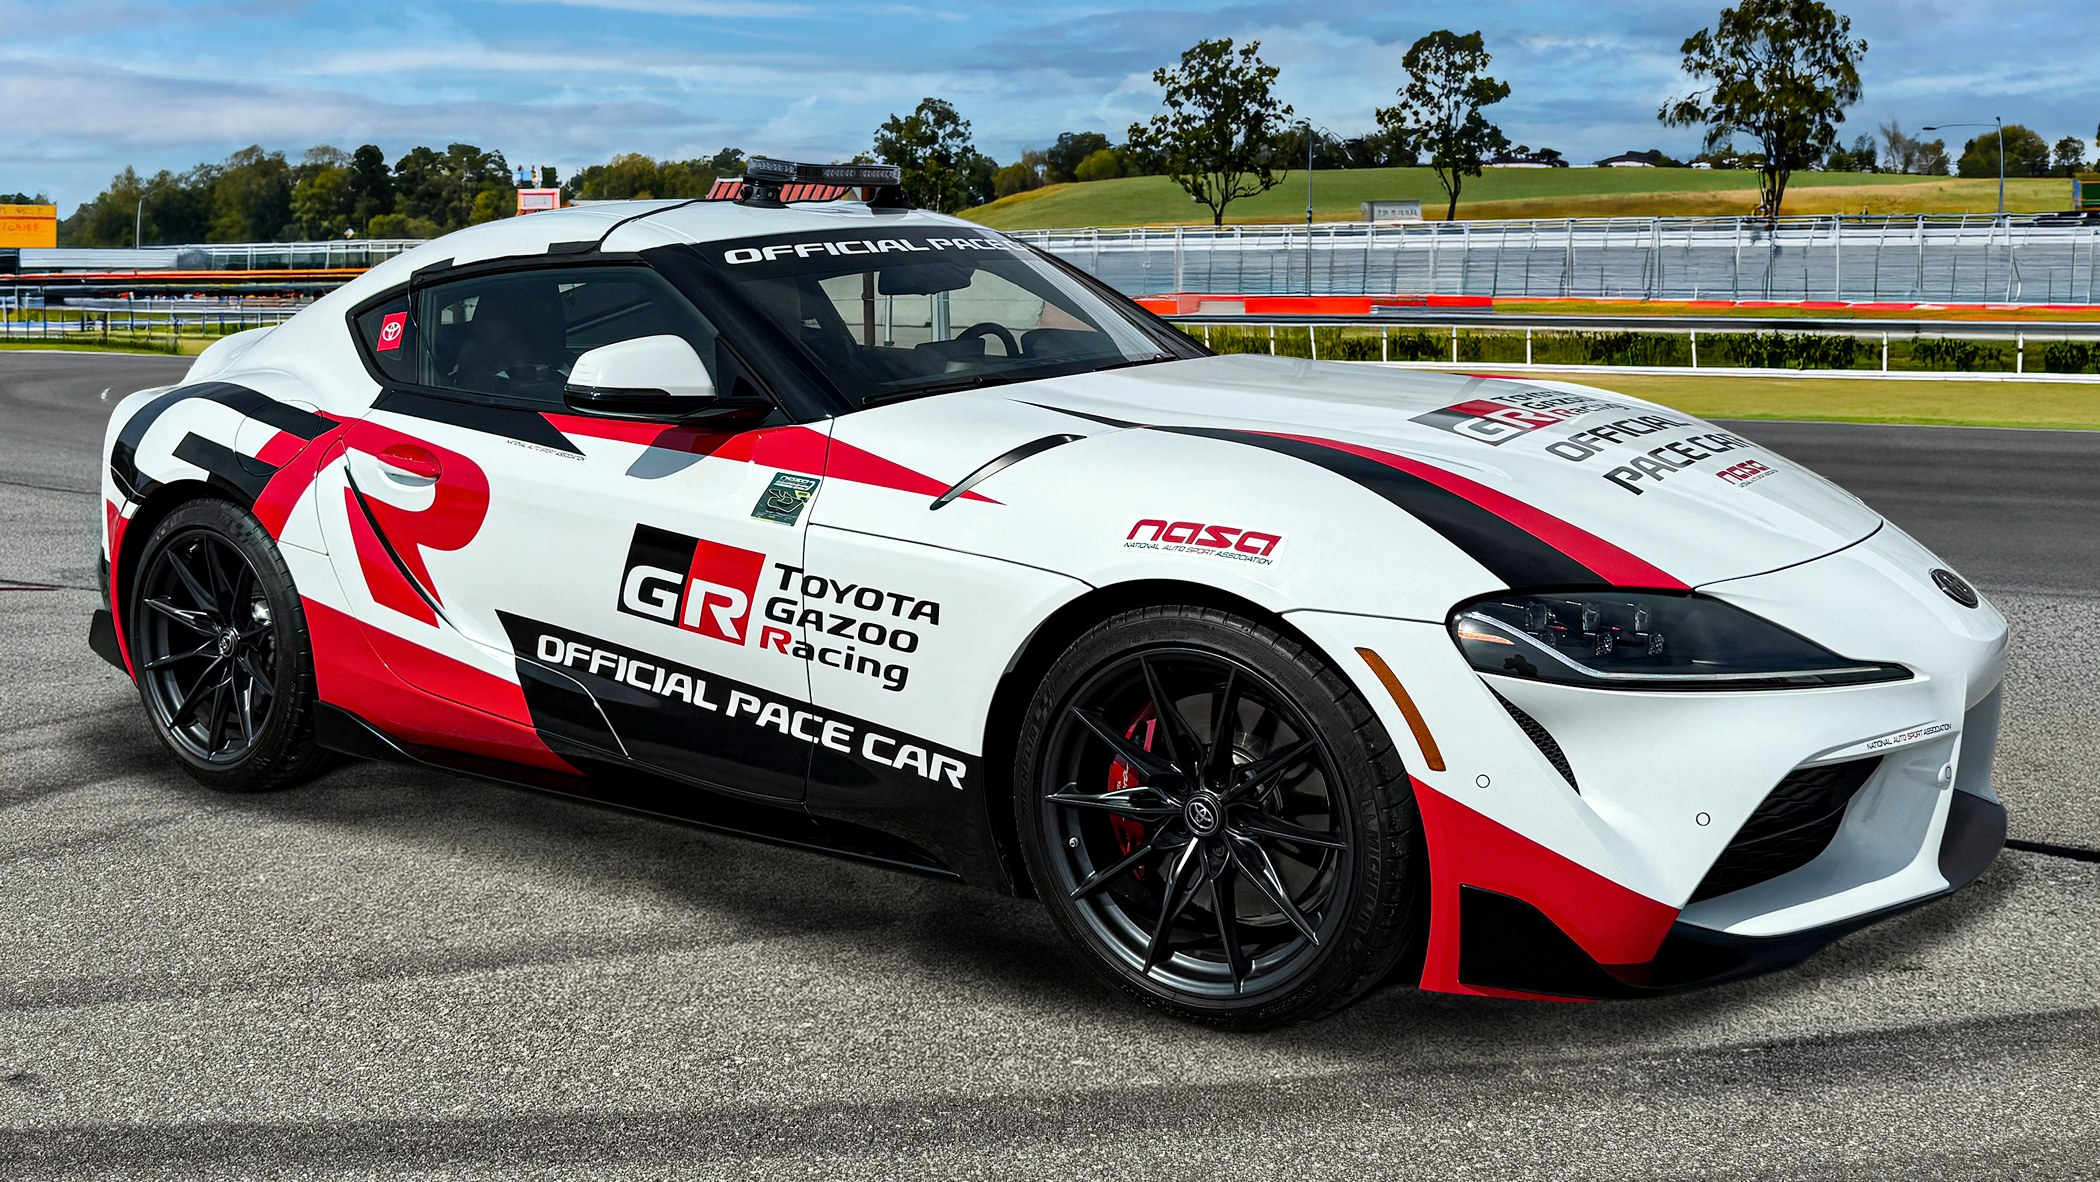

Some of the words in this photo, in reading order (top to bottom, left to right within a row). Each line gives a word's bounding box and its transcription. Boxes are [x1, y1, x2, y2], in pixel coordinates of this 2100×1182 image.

[724, 238, 931, 265] OFFICIAL
[926, 238, 1011, 251] PACE
[1452, 408, 1553, 443] GR
[1544, 415, 1693, 462] OFFICIAL
[1602, 441, 1713, 496] PACE
[1123, 541, 1160, 551] NATIONAL
[1161, 544, 1185, 552] AUTO
[1185, 546, 1216, 557] SPORT
[1215, 550, 1274, 566] ASSOCIATION
[1126, 518, 1282, 557] nasa
[623, 565, 749, 641] GR
[774, 562, 941, 627] TOYOTA
[764, 596, 919, 654] GAZOO
[759, 624, 910, 693] Racing
[536, 633, 718, 712] OFFICIAL
[725, 690, 854, 754] PACE
[861, 732, 968, 791] CAR
[1866, 738, 1893, 751] NATIONAL
[1893, 733, 1907, 744] AUTO
[1907, 729, 1924, 740] SPORT
[1923, 722, 1952, 736] ASSOCIATION
[1353, 829, 1383, 936] MICHELIN
